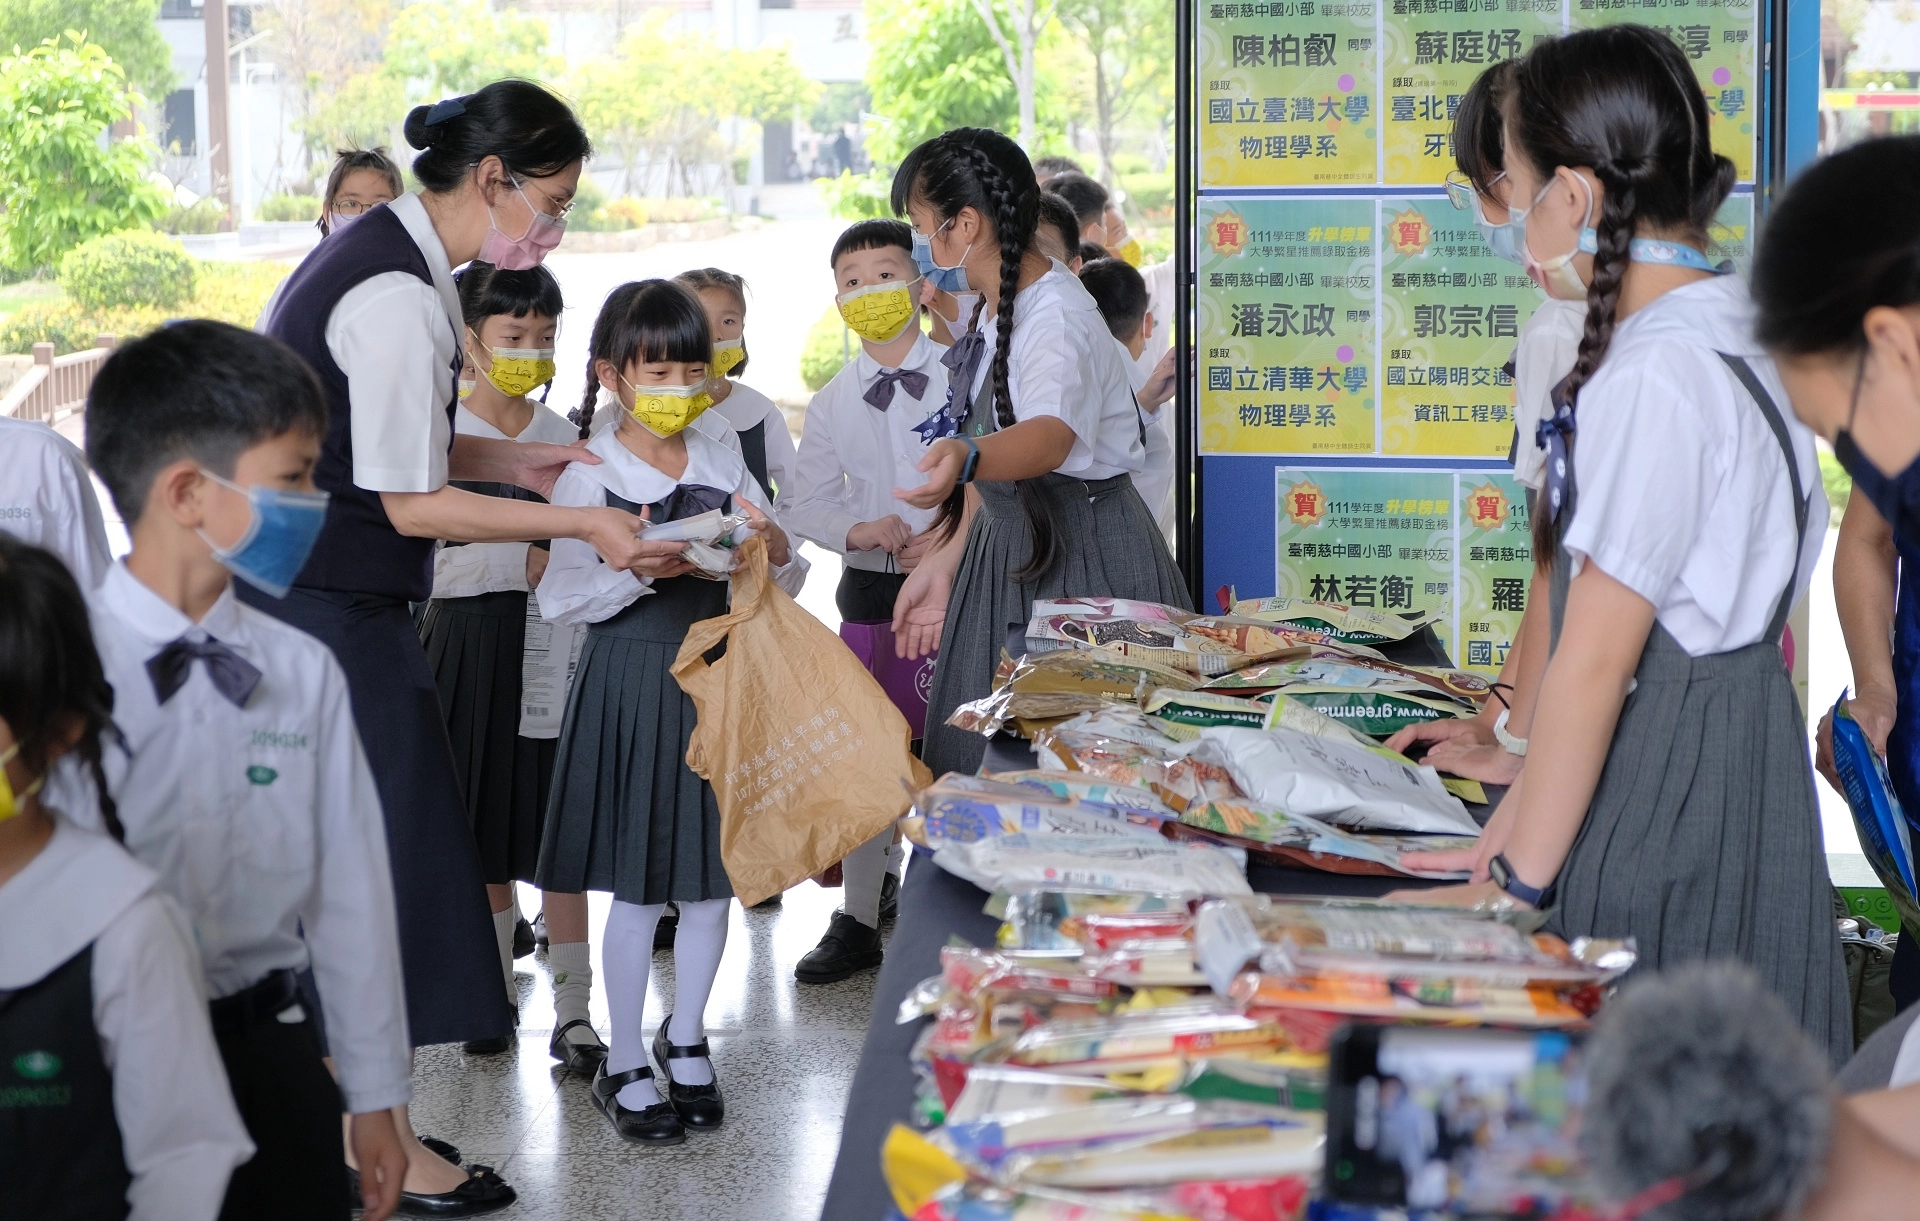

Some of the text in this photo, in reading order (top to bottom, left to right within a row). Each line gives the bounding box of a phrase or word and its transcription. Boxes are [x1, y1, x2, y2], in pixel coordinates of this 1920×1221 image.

[1210, 2, 1372, 18] 臺南慈中國小部 畢業校友
[1393, 0, 1558, 15] 臺南慈中國小部 畢業校友
[1232, 33, 1372, 68] 陳柏叡 同學
[1414, 29, 1522, 65] 蘇庭妤
[1648, 25, 1749, 59] 淳 同學
[1209, 80, 1231, 91] 錄取
[1393, 77, 1413, 87] 錄取
[1209, 96, 1370, 124] 國立臺灣大學
[1239, 134, 1338, 160] 物理學系
[1423, 133, 1457, 158] 牙
[1216, 222, 1240, 247] 賀
[1250, 226, 1372, 243] 111學年度 升學榜單
[1398, 222, 1422, 247] 賀
[1432, 245, 1498, 258] 大學繁星推
[1209, 272, 1371, 289] 臺南慈中國小部 畢業校友
[1391, 272, 1498, 288] 臺南慈中國小部
[1231, 303, 1371, 338] 潘永政 同學
[1413, 304, 1518, 338] 郭宗信
[1209, 348, 1230, 359] 錄取
[1391, 349, 1411, 360] 錄取
[1208, 366, 1368, 393] 國立清華大學
[1387, 366, 1516, 386] 國立陽明交通
[1239, 403, 1336, 428] 物理學系
[1294, 493, 1317, 517] 賀
[1328, 499, 1449, 515] 111學年度 升學榜單
[1476, 496, 1500, 521] 賀
[1510, 504, 1528, 517] 11
[1328, 517, 1449, 530] 大學繁星推薦錄取金榜
[1288, 543, 1449, 561] 臺南慈中國小部 畢業校友
[1310, 574, 1414, 609] 林若衡
[1424, 583, 1449, 595] 同學
[1492, 578, 1532, 612] 羅
[1469, 623, 1490, 633] 錄取
[1313, 703, 1440, 718] www.greenma
